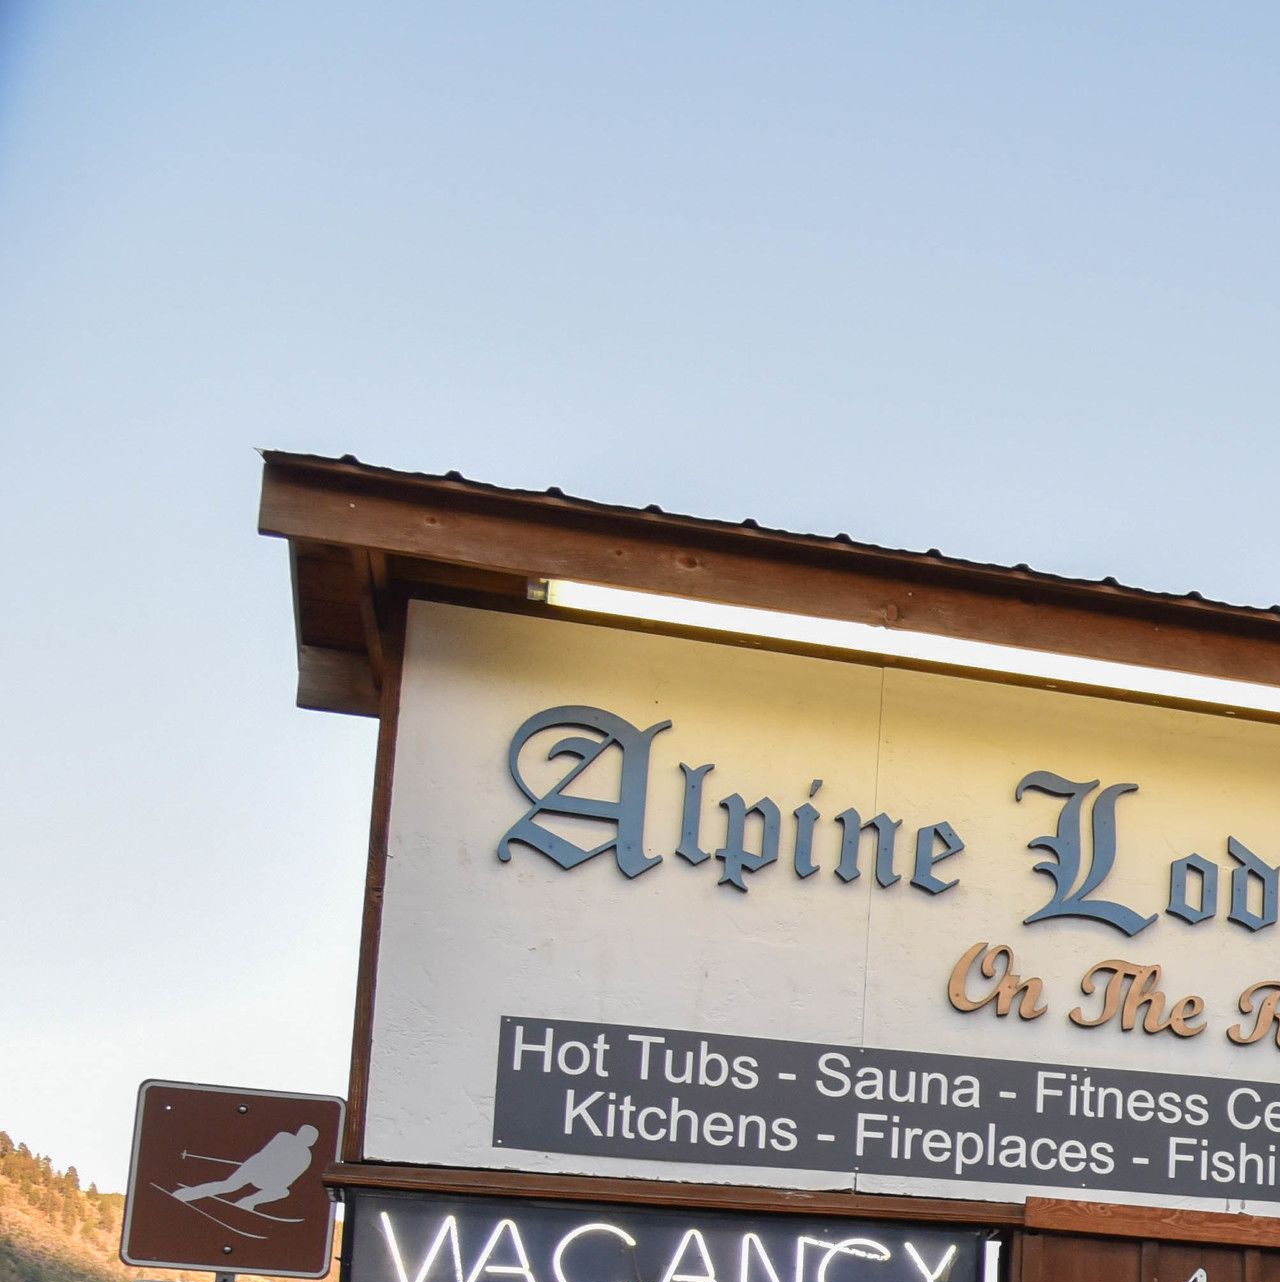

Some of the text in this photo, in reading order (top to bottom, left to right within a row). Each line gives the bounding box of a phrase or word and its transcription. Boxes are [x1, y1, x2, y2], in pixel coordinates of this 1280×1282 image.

[497, 703, 967, 893] Alpine
[946, 941, 1049, 1020] On
[1068, 959, 1208, 1039] The
[511, 1025, 610, 1078] Hot
[627, 1034, 760, 1091] Tubs
[815, 1052, 982, 1108] Sauna
[1034, 1070, 1209, 1126] Fitness
[563, 1089, 799, 1152] Kitchens
[855, 1117, 1116, 1176] Fireplaces
